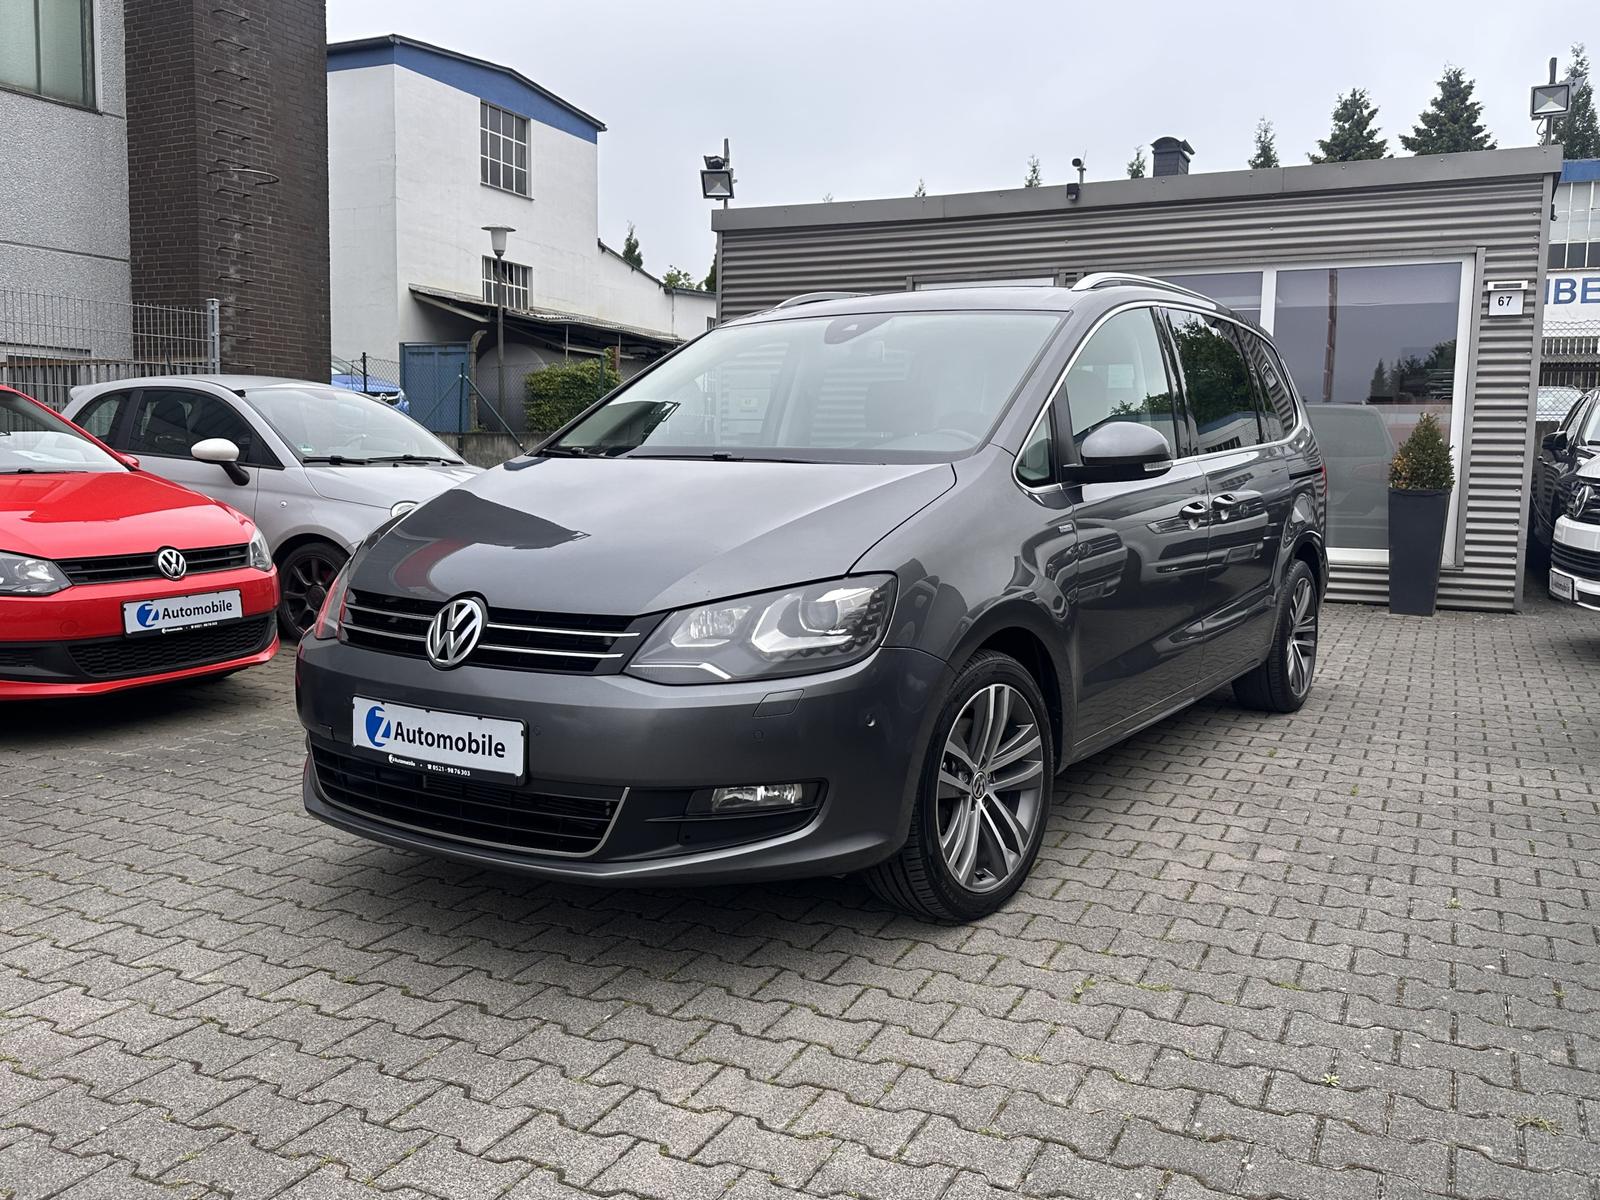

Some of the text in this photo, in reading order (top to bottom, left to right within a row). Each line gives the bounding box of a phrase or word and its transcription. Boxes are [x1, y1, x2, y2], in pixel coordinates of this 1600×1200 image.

[1497, 296, 1513, 306] 67
[162, 600, 233, 620] Automobile
[393, 721, 506, 758] Automobile
